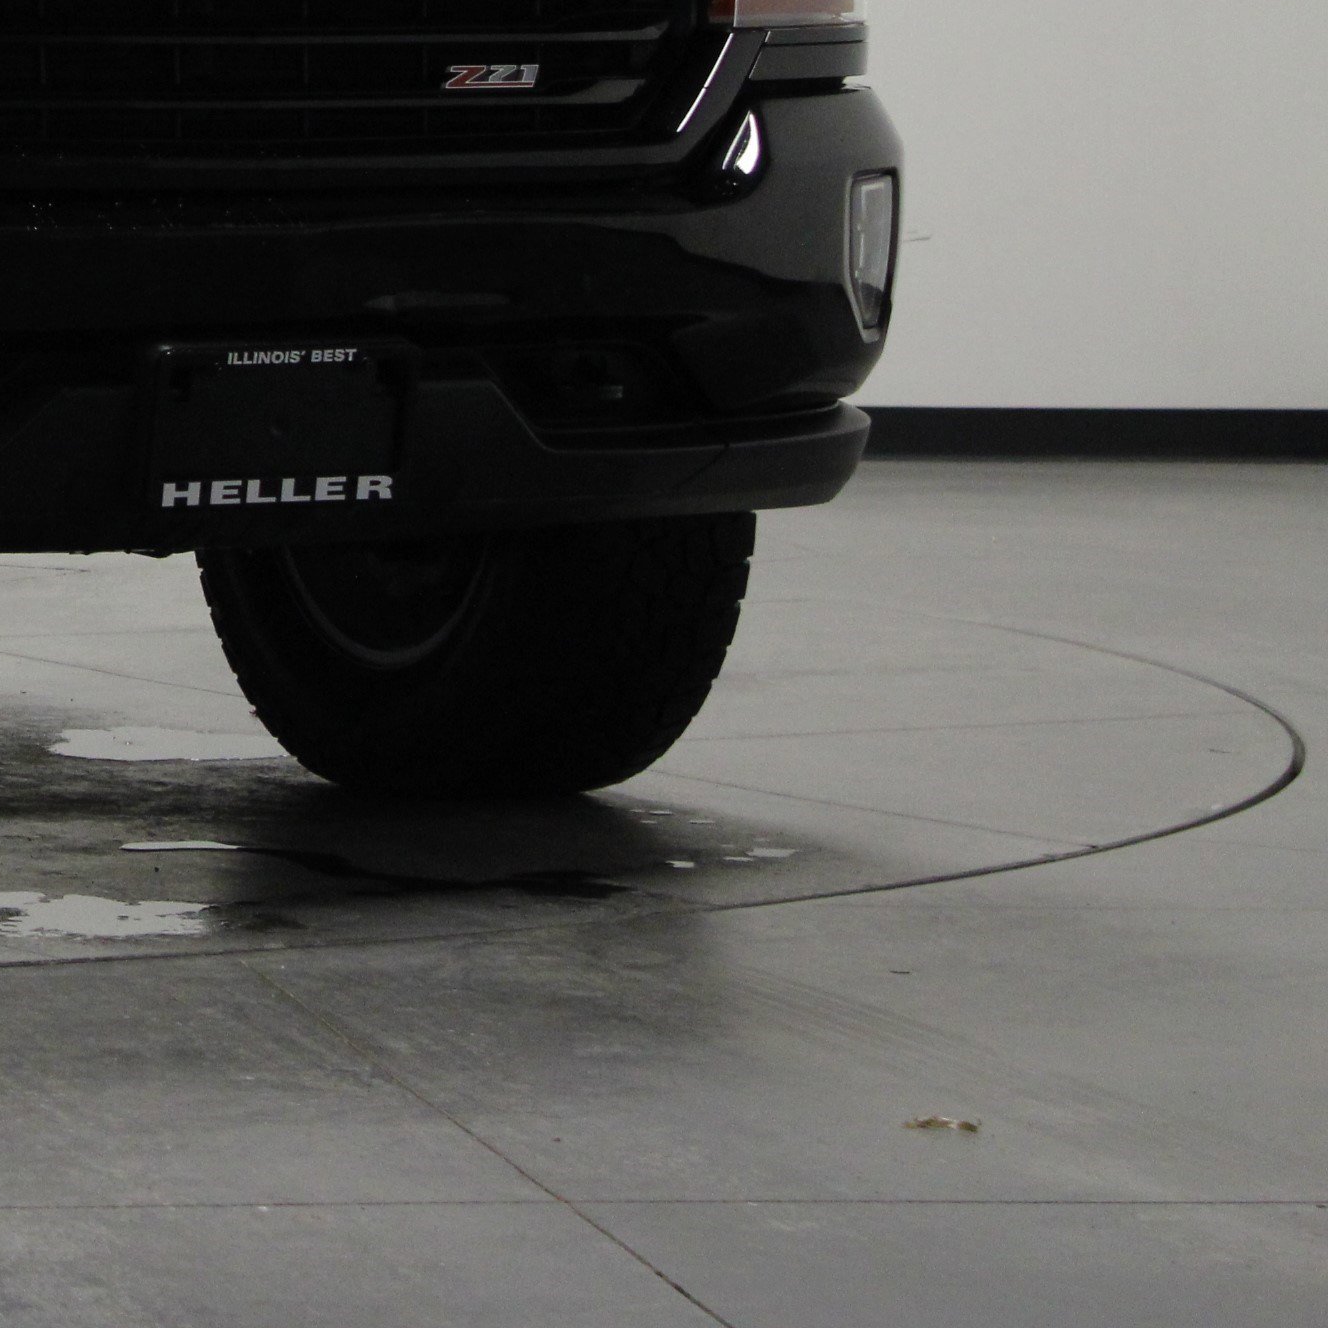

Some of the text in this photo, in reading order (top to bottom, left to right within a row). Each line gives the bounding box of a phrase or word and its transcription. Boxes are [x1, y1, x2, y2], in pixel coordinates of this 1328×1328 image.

[445, 64, 539, 89] Z71
[311, 348, 357, 363] BEST
[161, 475, 394, 507] HELLER
